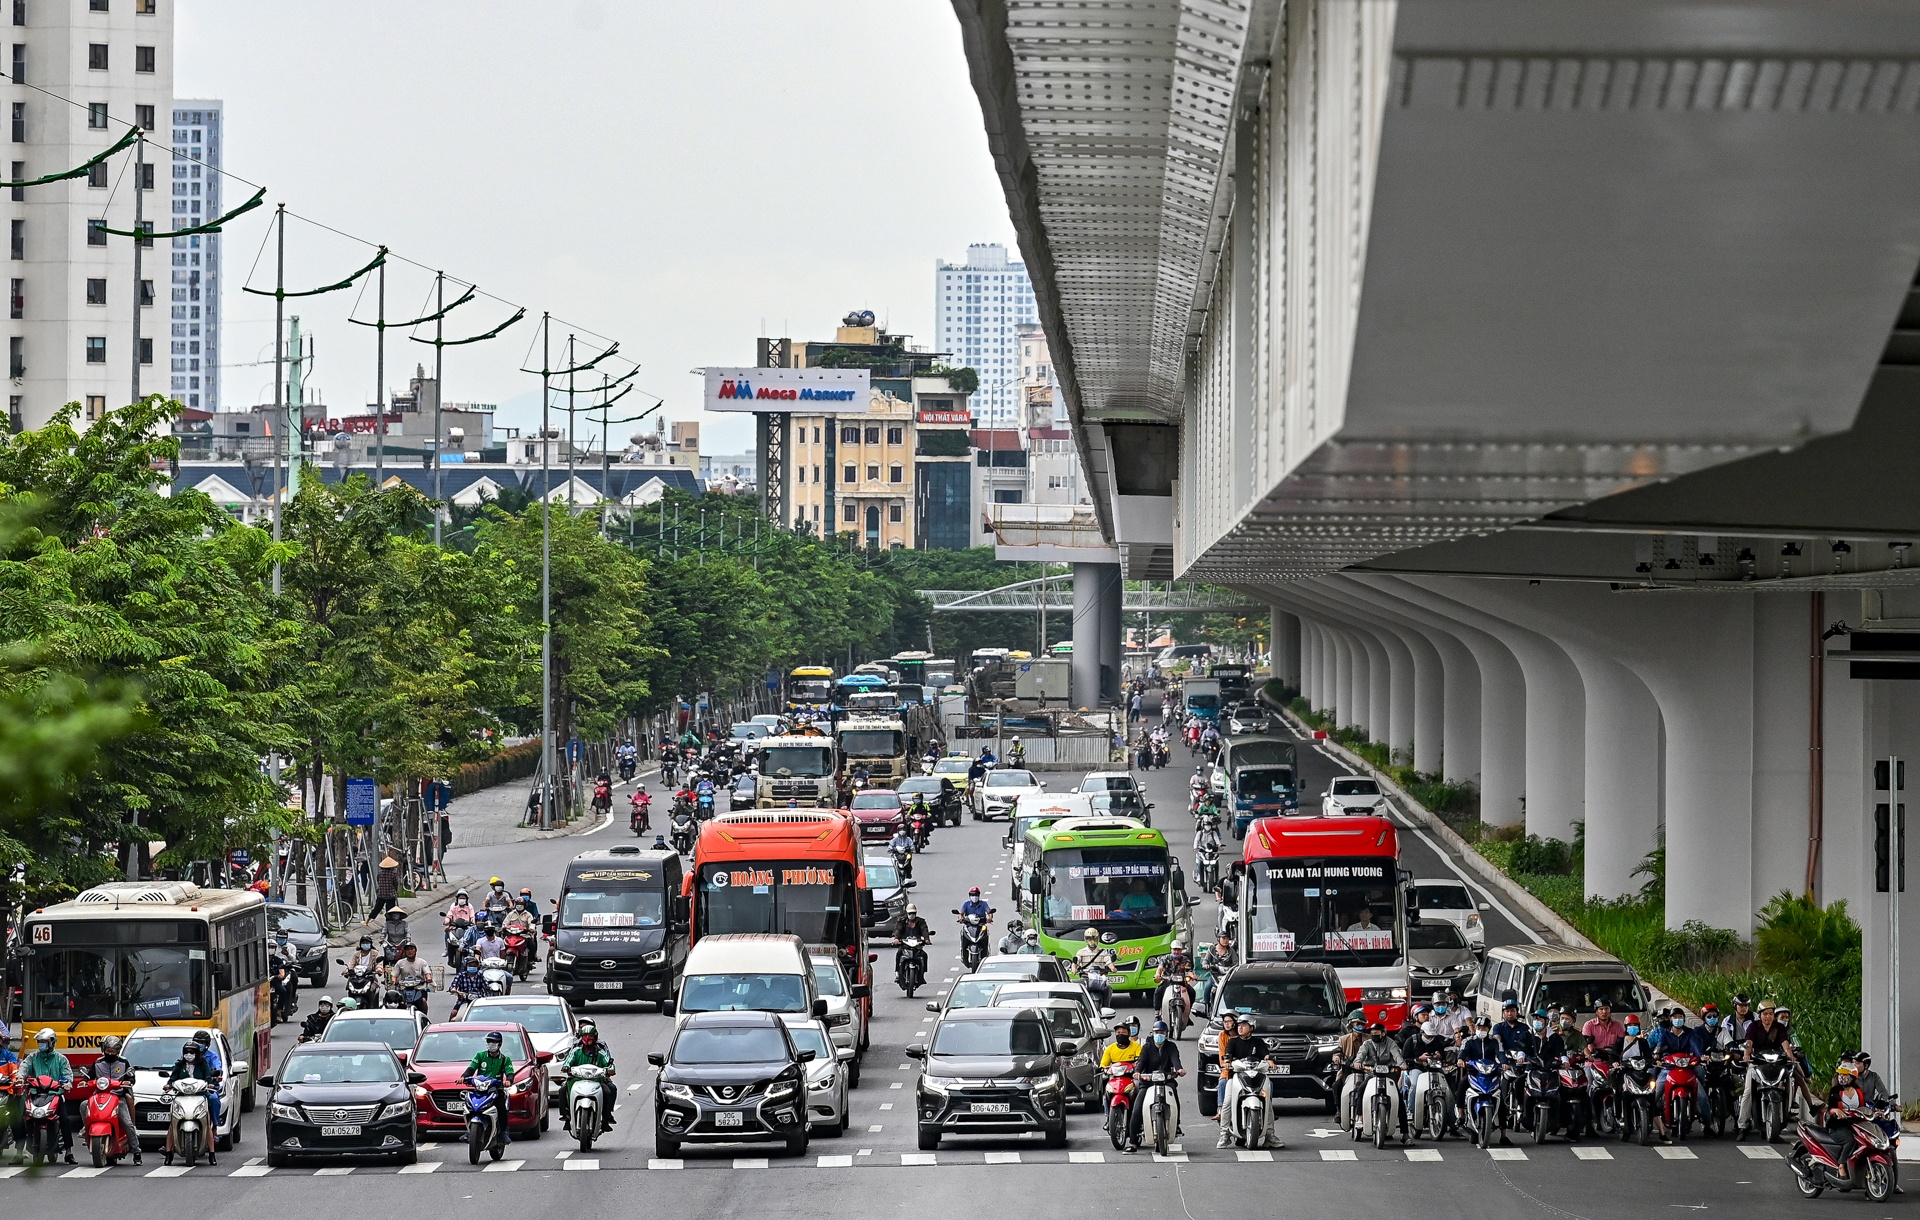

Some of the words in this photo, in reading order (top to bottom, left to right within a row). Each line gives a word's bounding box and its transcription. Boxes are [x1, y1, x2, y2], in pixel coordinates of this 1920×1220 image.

[923, 412, 934, 422] NỘI
[935, 411, 950, 422] THẤT
[950, 413, 968, 422] VARA
[730, 867, 774, 887] HOÀNG
[782, 866, 835, 885] PHƯƠNG
[1090, 866, 1100, 875] ĐÌNH
[1125, 866, 1131, 874] TP
[1140, 866, 1149, 874] NINH
[1265, 869, 1283, 879] HTX
[1285, 868, 1304, 878] VAN
[1306, 868, 1321, 877] TAI
[1324, 867, 1349, 877] HUNG
[1351, 867, 1383, 877] VUONG
[1073, 906, 1085, 920] MỸ
[1086, 906, 1104, 919] ĐÌNH
[583, 915, 592, 926] HÀ
[592, 914, 604, 926] NỘI
[609, 914, 618, 925] MỸ
[618, 914, 633, 925] ĐÌNH
[34, 927, 50, 941] 46
[1118, 945, 1144, 956] Bus
[1254, 939, 1278, 951] MÓNG
[1280, 939, 1293, 951] CÁI
